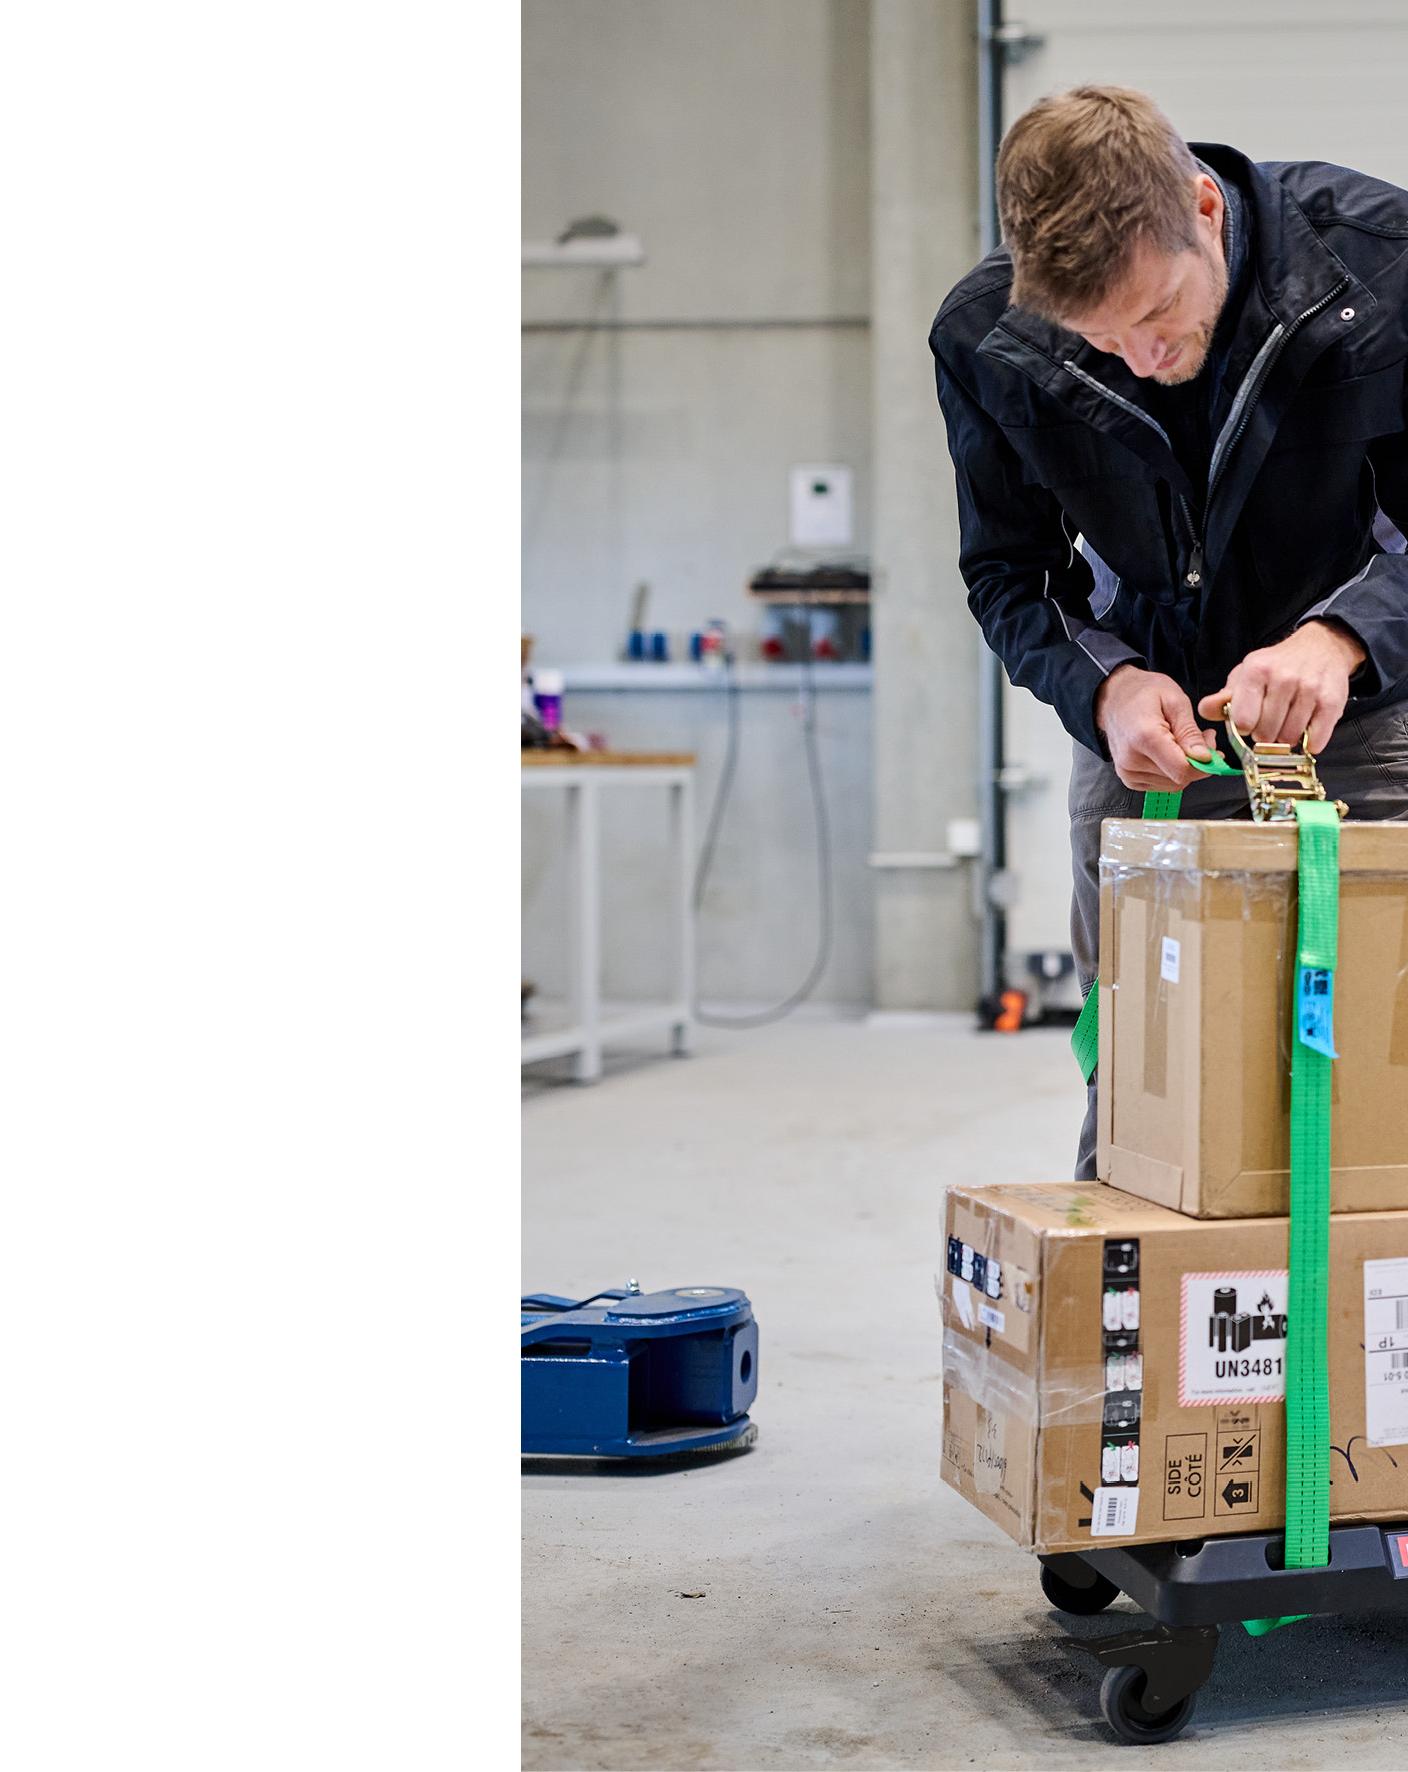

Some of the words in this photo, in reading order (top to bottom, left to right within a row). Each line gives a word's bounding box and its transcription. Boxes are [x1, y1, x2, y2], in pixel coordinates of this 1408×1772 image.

[1378, 1336, 1395, 1349] 1P
[1215, 1357, 1283, 1379] UN3481
[1167, 1459, 1182, 1495] SIDE
[1184, 1453, 1203, 1498] CÔTÉ
[1231, 1488, 1245, 1498] 3
